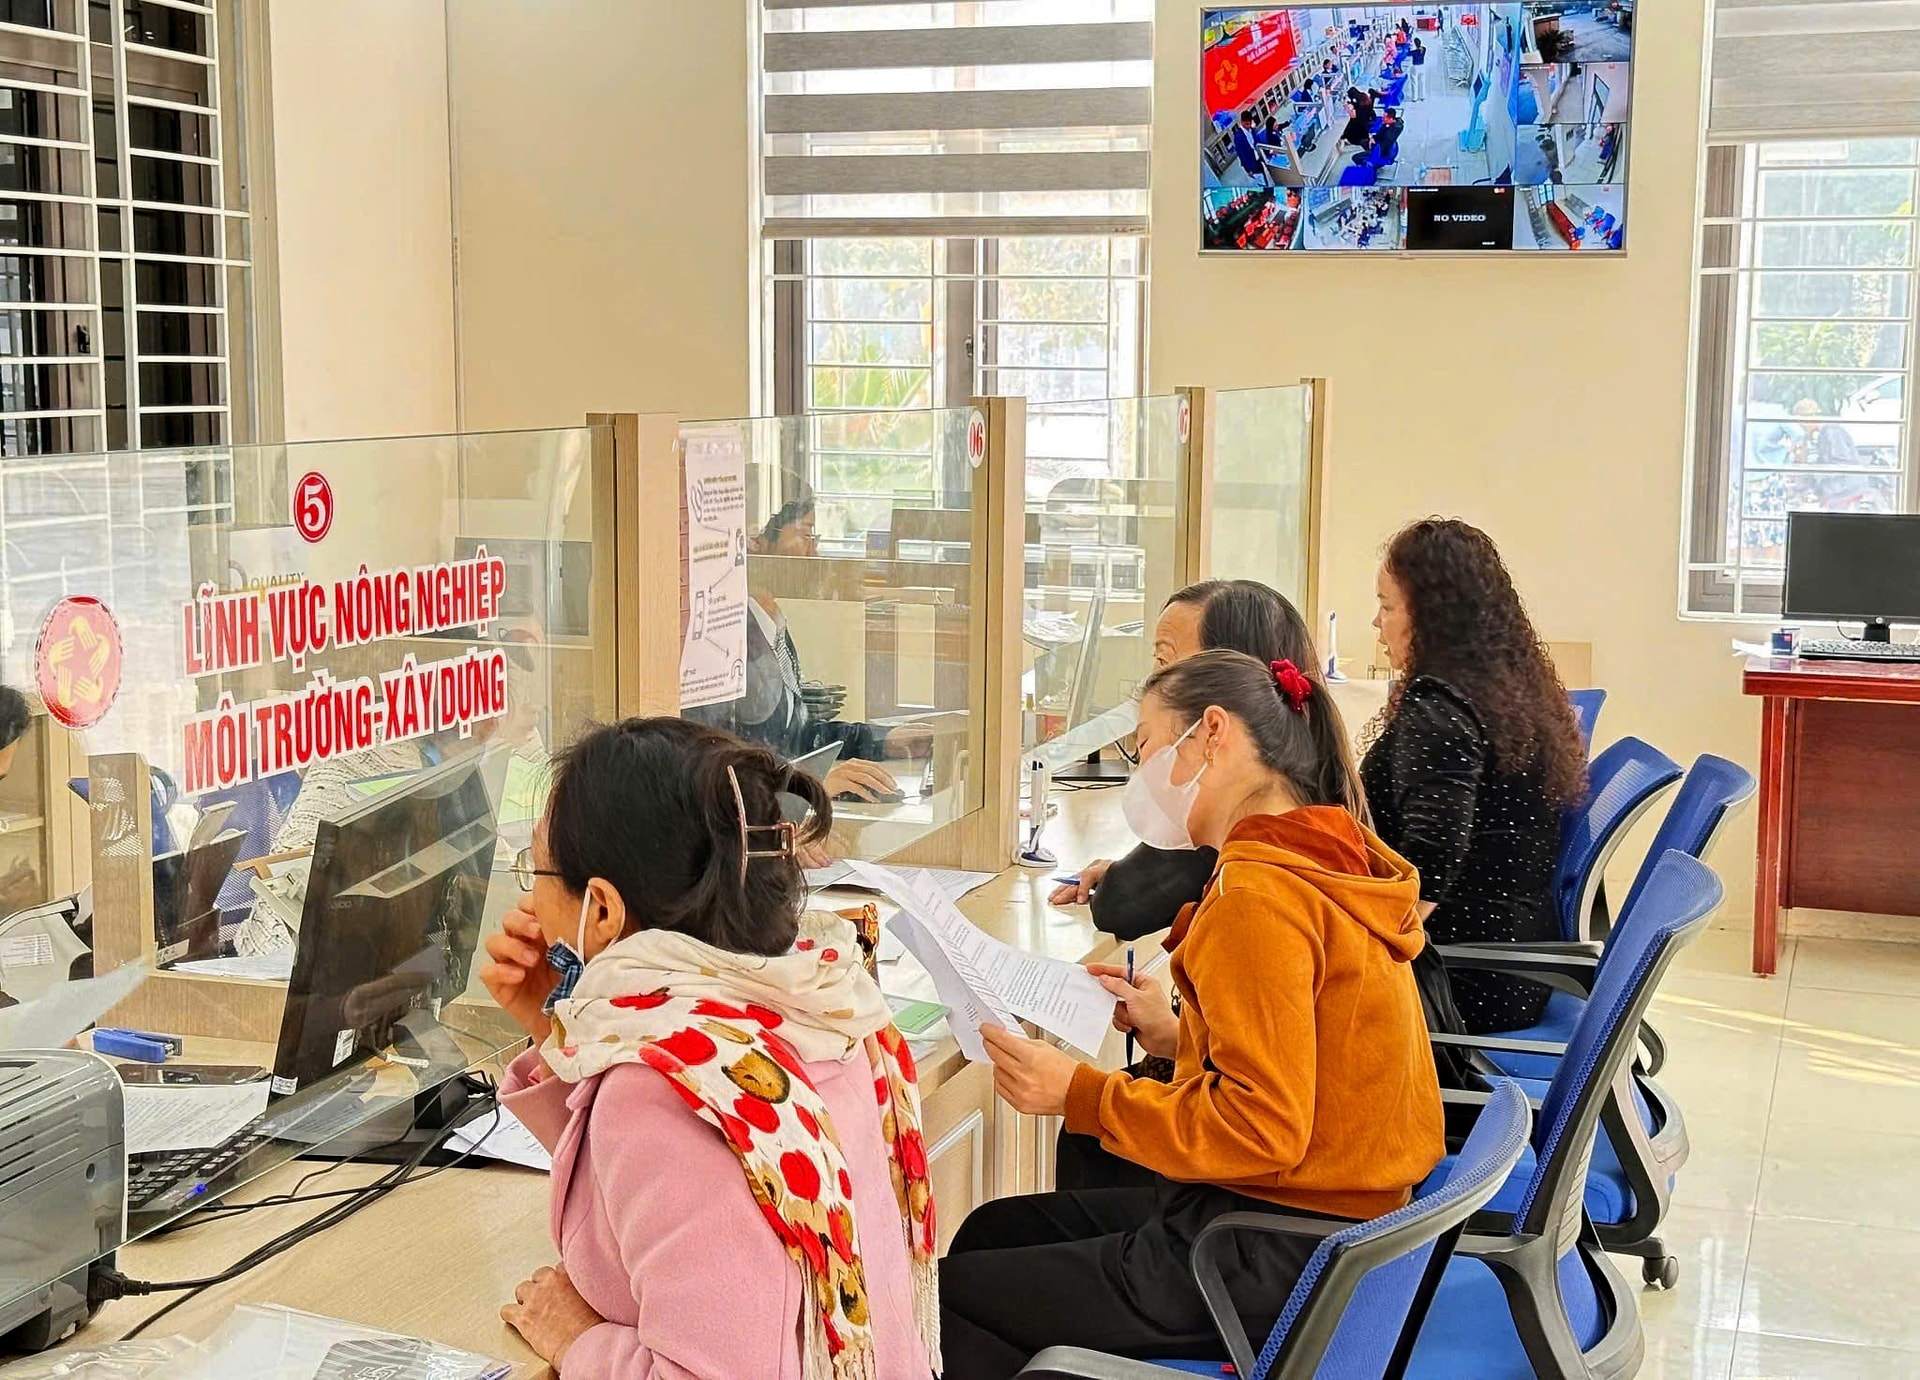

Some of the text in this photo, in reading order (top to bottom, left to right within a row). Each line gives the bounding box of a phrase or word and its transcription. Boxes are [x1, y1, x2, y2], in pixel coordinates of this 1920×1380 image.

[1433, 213, 1487, 222] NO VIDEO
[969, 421, 983, 458] 06
[302, 482, 326, 533] 5
[183, 548, 504, 676] LĨNH VỰC NÔNG NGHIỆP
[183, 697, 249, 794] MÔI
[440, 654, 505, 734] DỰNG
